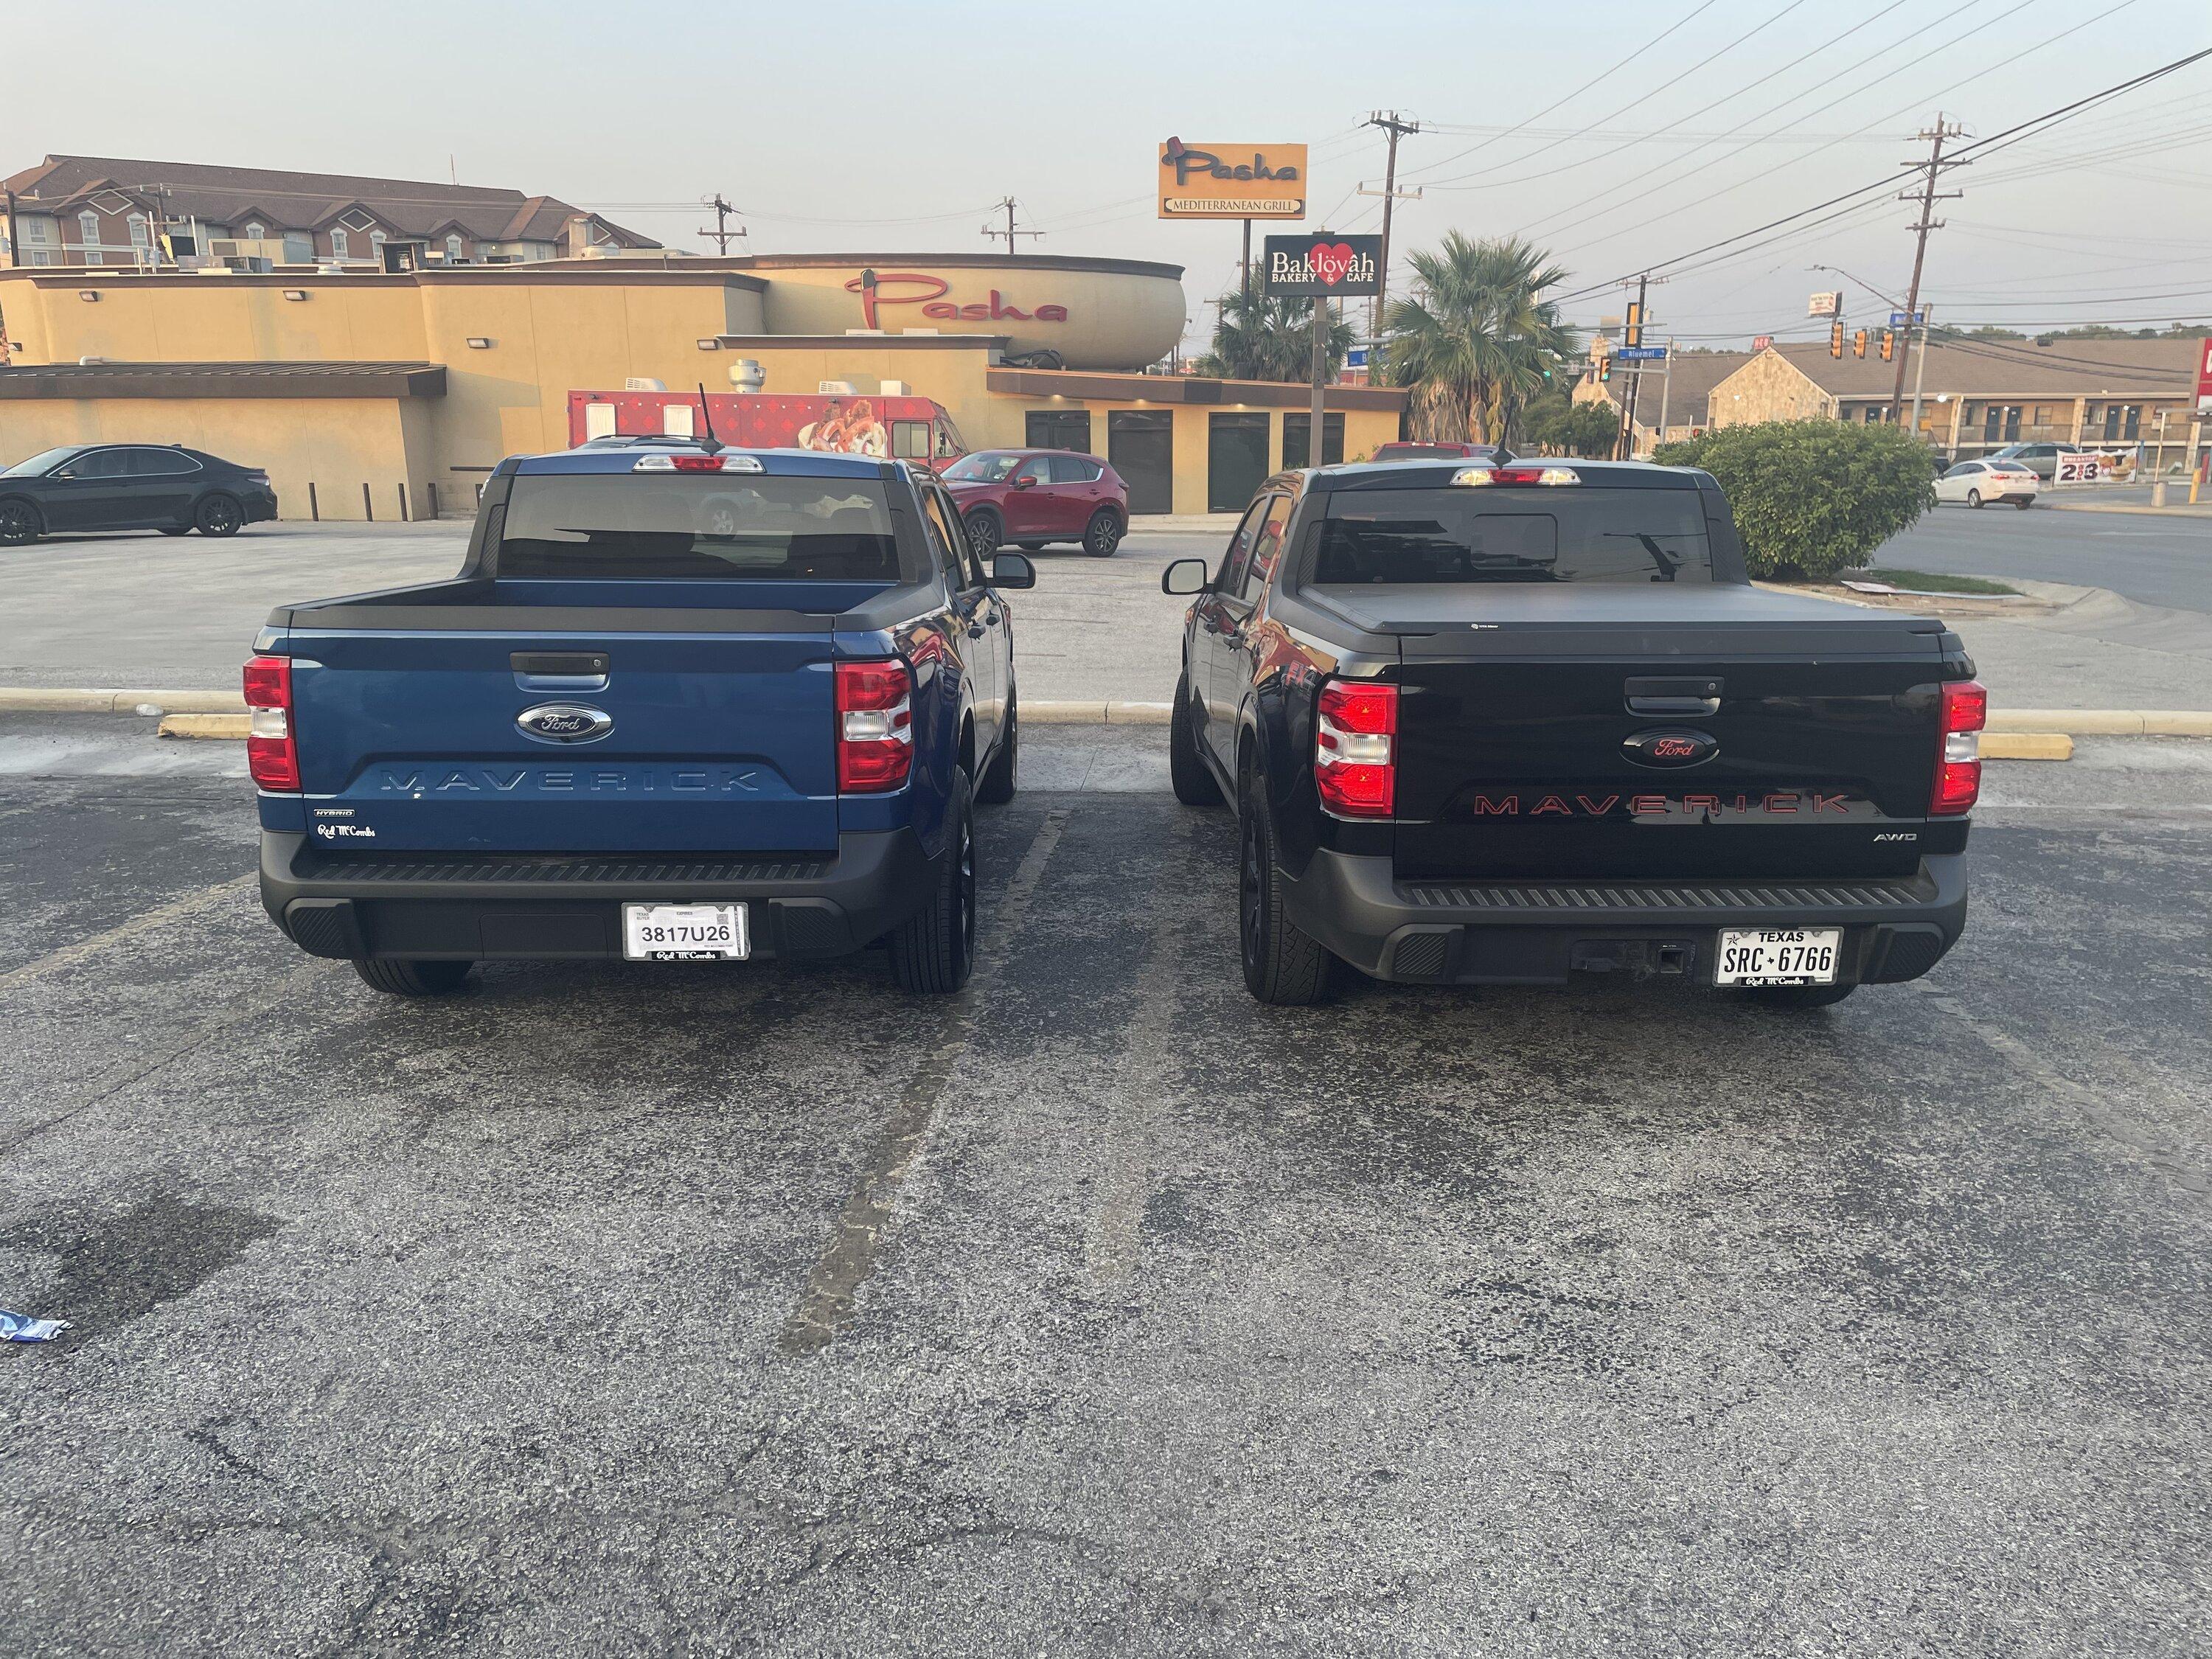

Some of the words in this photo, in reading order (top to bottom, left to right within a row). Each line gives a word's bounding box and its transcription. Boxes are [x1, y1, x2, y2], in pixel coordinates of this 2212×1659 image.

[1161, 149, 1298, 186] Pasha
[1173, 200, 1262, 211] MEDITERRANEAN
[1263, 201, 1293, 211] GRILL
[1271, 251, 1375, 274] Baklövâh
[1271, 273, 1317, 282] BAKERY
[1326, 274, 1335, 282] &
[1346, 273, 1374, 282] CAFE
[844, 273, 1068, 330] Pasha
[540, 714, 580, 731] Ford
[1654, 739, 1694, 756] Ford
[380, 771, 759, 791] MAVERICK
[1475, 794, 1849, 815] MAVERICK
[1873, 832, 1918, 842] AWD
[641, 925, 730, 942] 3817U26
[1759, 931, 1805, 943] TEXAS
[1724, 947, 1764, 973] SRC
[1778, 947, 1832, 972] 6766
